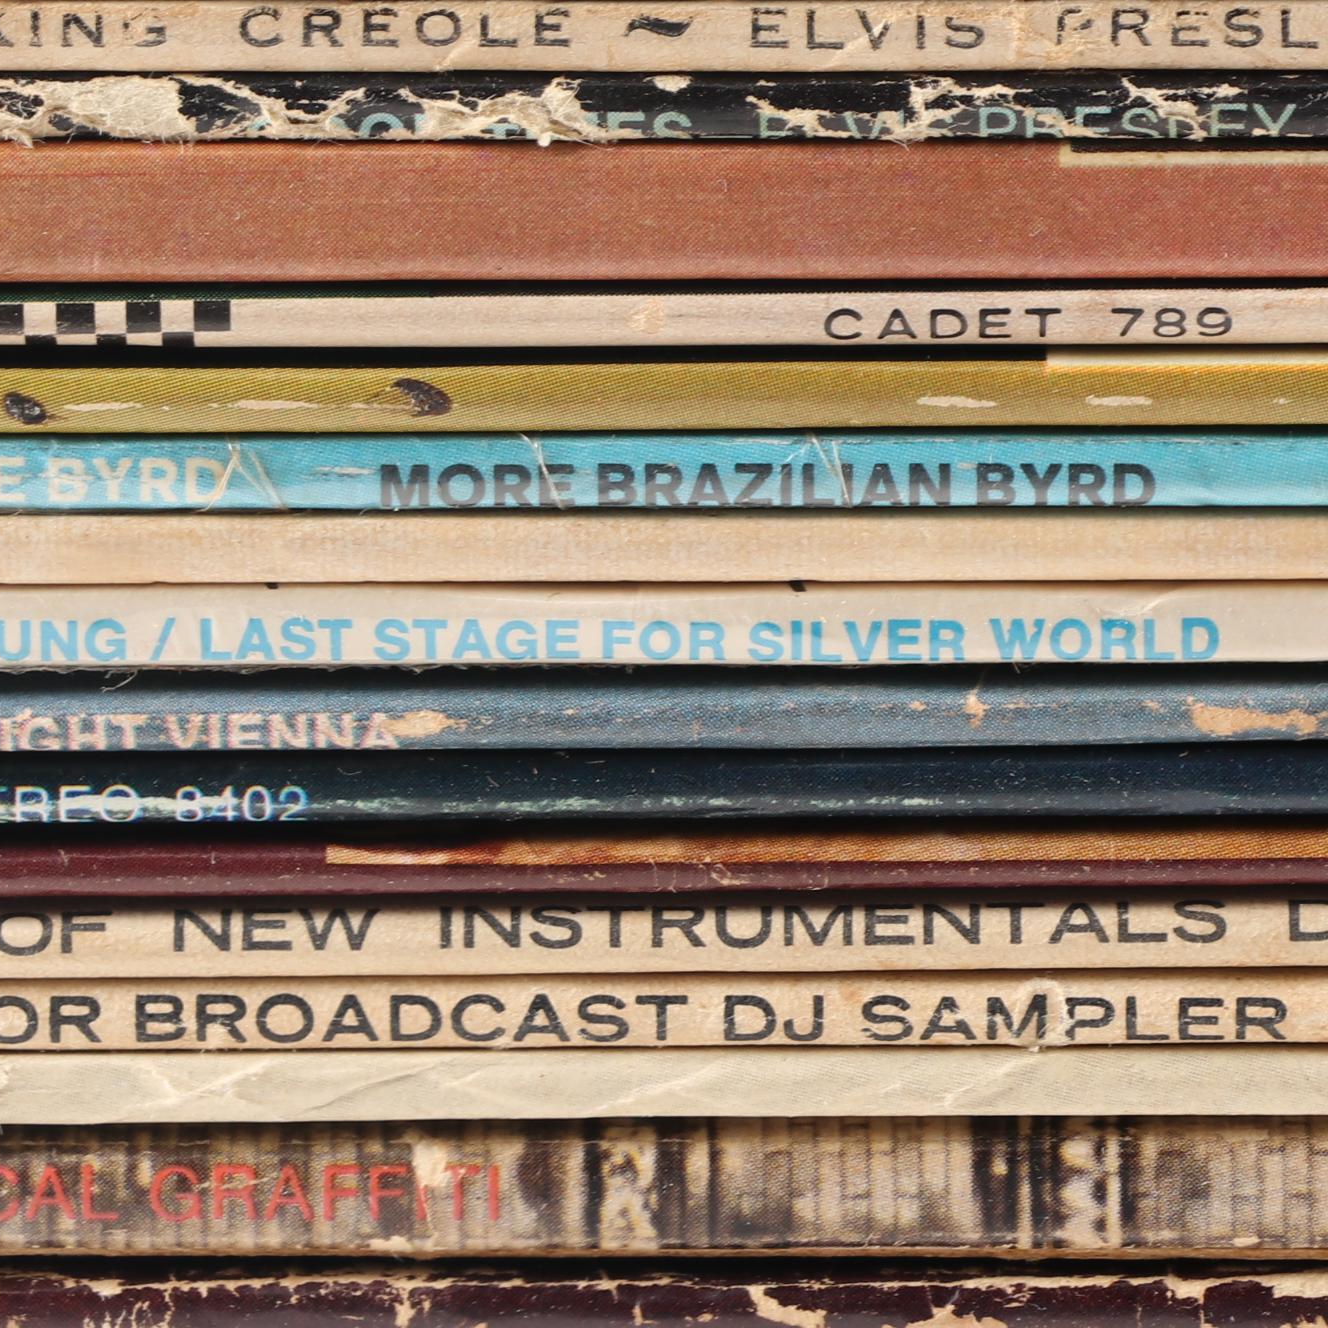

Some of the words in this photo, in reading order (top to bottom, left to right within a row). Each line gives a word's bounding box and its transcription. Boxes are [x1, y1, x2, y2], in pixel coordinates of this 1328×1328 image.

[238, 7, 572, 48] CREOLE
[751, 6, 987, 51] ELVIS
[823, 307, 1064, 340] CADET
[1110, 306, 1234, 339] 789
[46, 455, 230, 506] BYRD
[378, 461, 576, 510] MORE
[597, 461, 953, 509] BRAZILIAN
[976, 460, 1159, 507] BYRD
[199, 616, 354, 662] LAST
[373, 617, 581, 662] STAGE
[601, 617, 726, 662] FOR
[746, 616, 966, 661] SILVER
[990, 616, 1222, 661] WORLD
[163, 711, 401, 751] VIENNA
[173, 783, 309, 823] 8402
[172, 906, 384, 952] NEW
[438, 899, 1229, 951] INSTRUMENTALS
[134, 992, 689, 1044] BROADCAST
[722, 993, 826, 1043] DJ
[862, 991, 1290, 1044] SAMPLER
[149, 1162, 502, 1224] GRAFFTI
